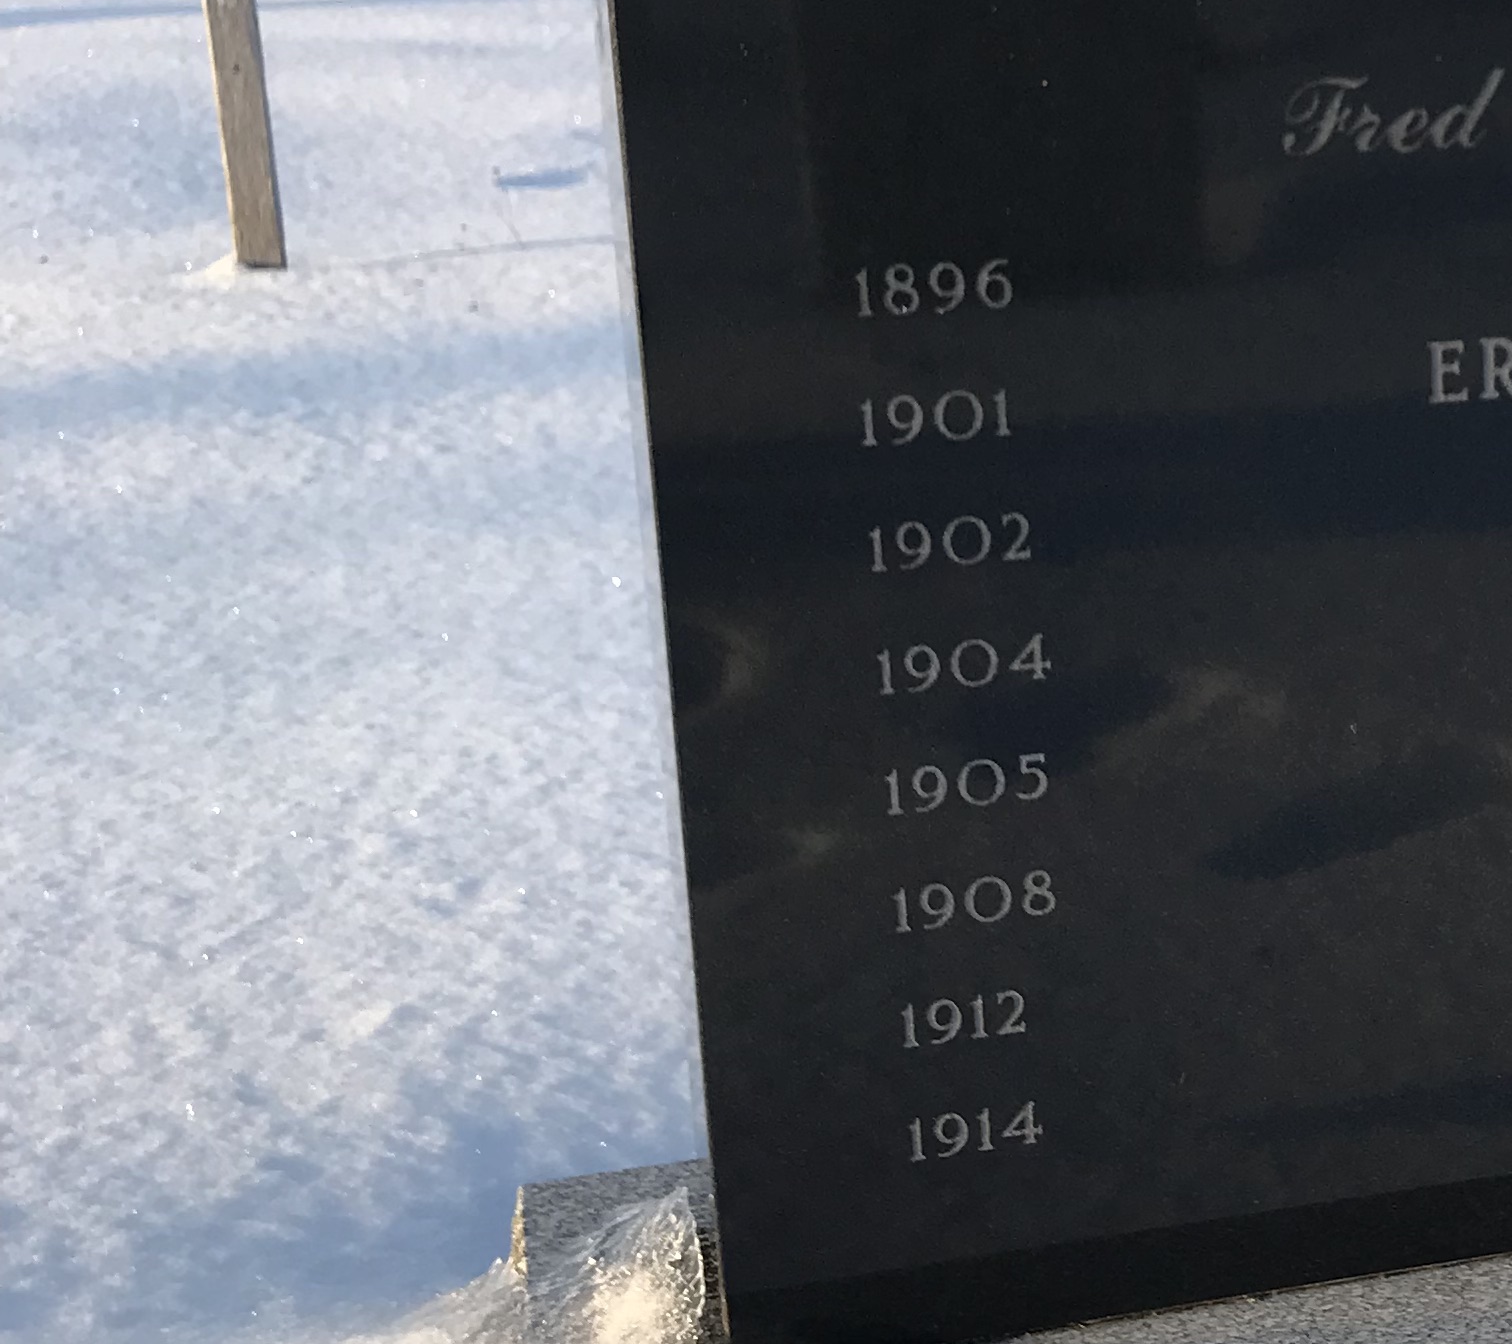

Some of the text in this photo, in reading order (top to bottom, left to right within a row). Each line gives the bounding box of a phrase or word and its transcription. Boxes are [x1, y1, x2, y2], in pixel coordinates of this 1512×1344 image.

[1283, 67, 1504, 156] Fred
[854, 258, 1014, 317] 1896
[860, 388, 1012, 448] 1901
[869, 511, 1033, 573] 1902
[876, 631, 1053, 696] 1904
[883, 751, 1050, 817] 1905
[892, 868, 1058, 934] 1908
[899, 988, 1028, 1050] 1912
[908, 1099, 1045, 1164] 1914
